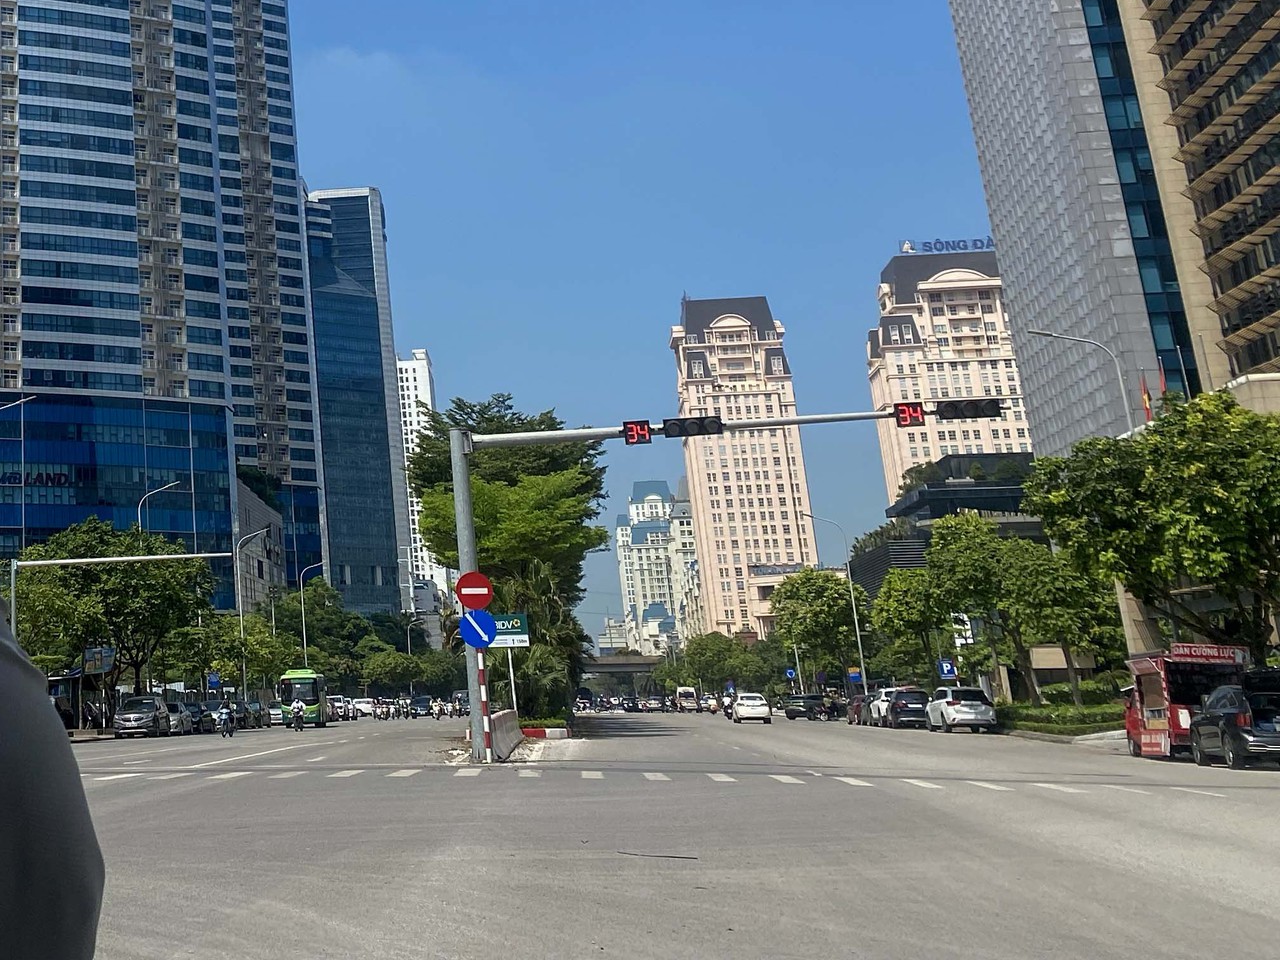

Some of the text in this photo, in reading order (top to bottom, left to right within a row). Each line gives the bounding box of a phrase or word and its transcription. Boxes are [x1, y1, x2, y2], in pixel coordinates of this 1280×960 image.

[922, 239, 968, 252] SÔNG
[898, 406, 923, 425] 34
[627, 424, 650, 442] 34
[24, 472, 69, 487] LAND
[943, 663, 951, 674] P
